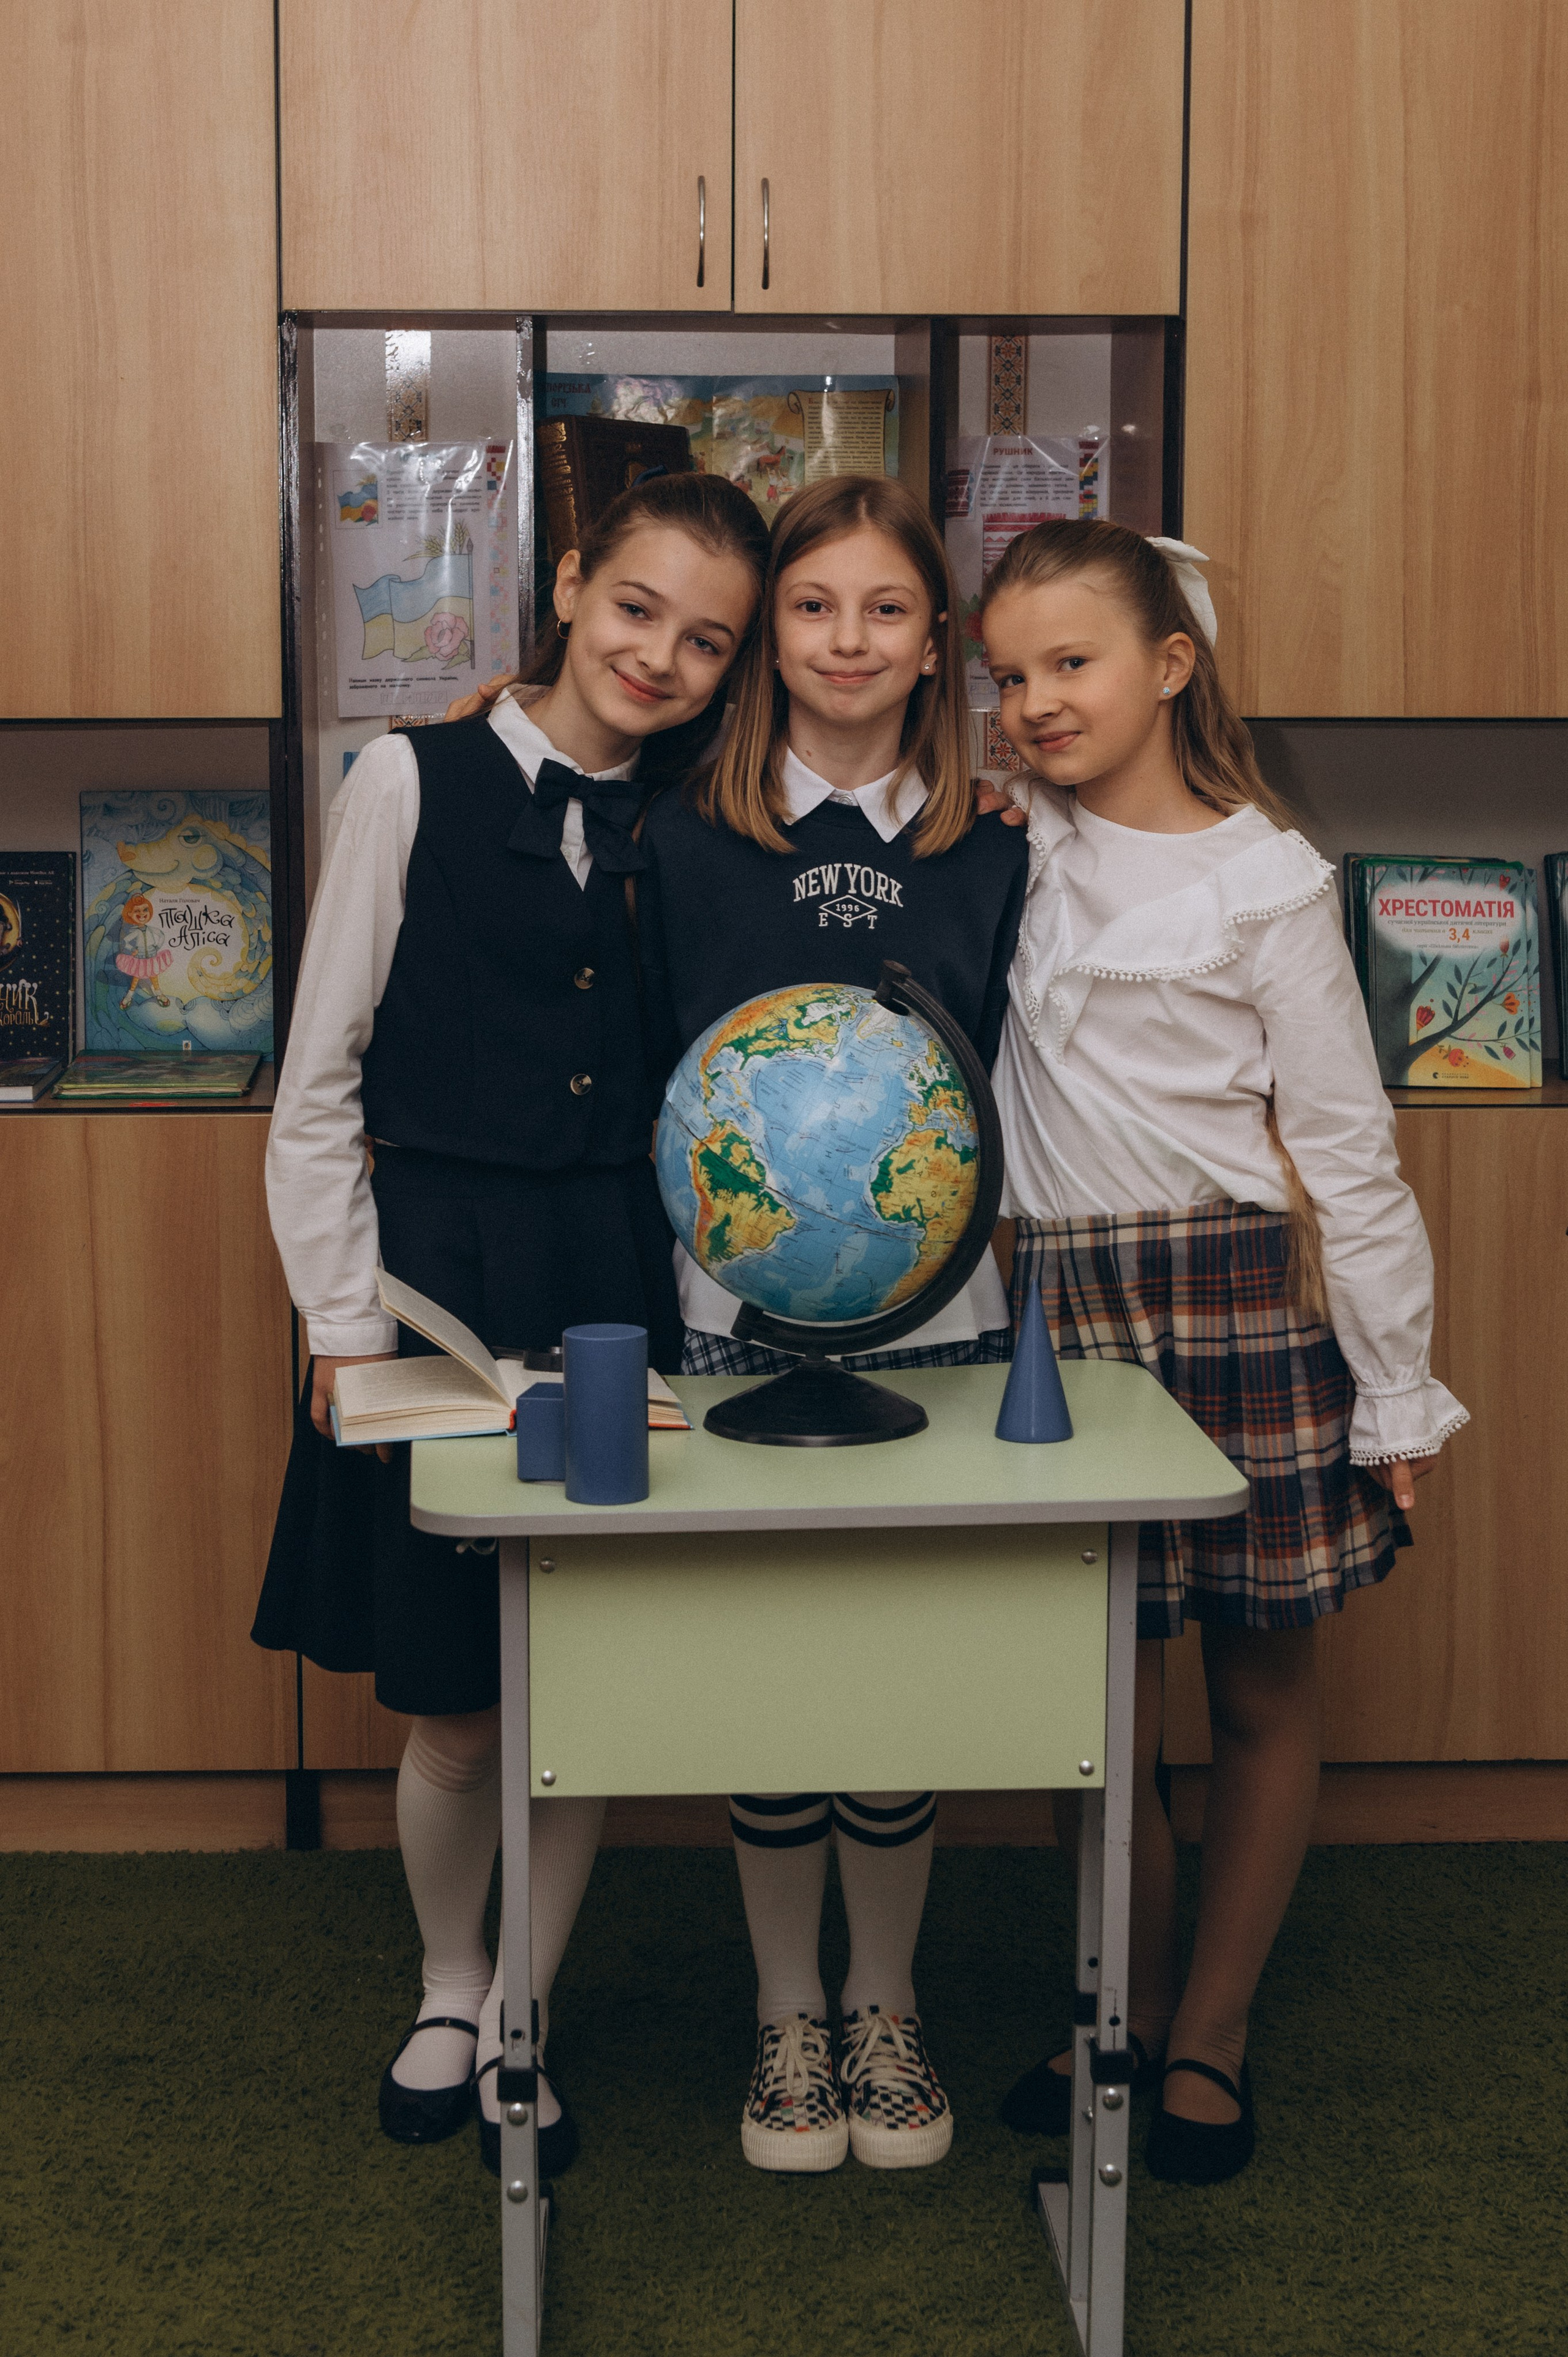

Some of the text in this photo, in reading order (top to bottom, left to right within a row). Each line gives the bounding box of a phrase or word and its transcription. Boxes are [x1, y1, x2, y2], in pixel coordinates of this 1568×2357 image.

[793, 863, 904, 908] NEW YORK
[835, 903, 860, 913] 1996
[1378, 898, 1515, 918] ХРЕСТОМАТІЯ
[168, 925, 230, 951] Аліса
[1449, 927, 1471, 943] 3,4
